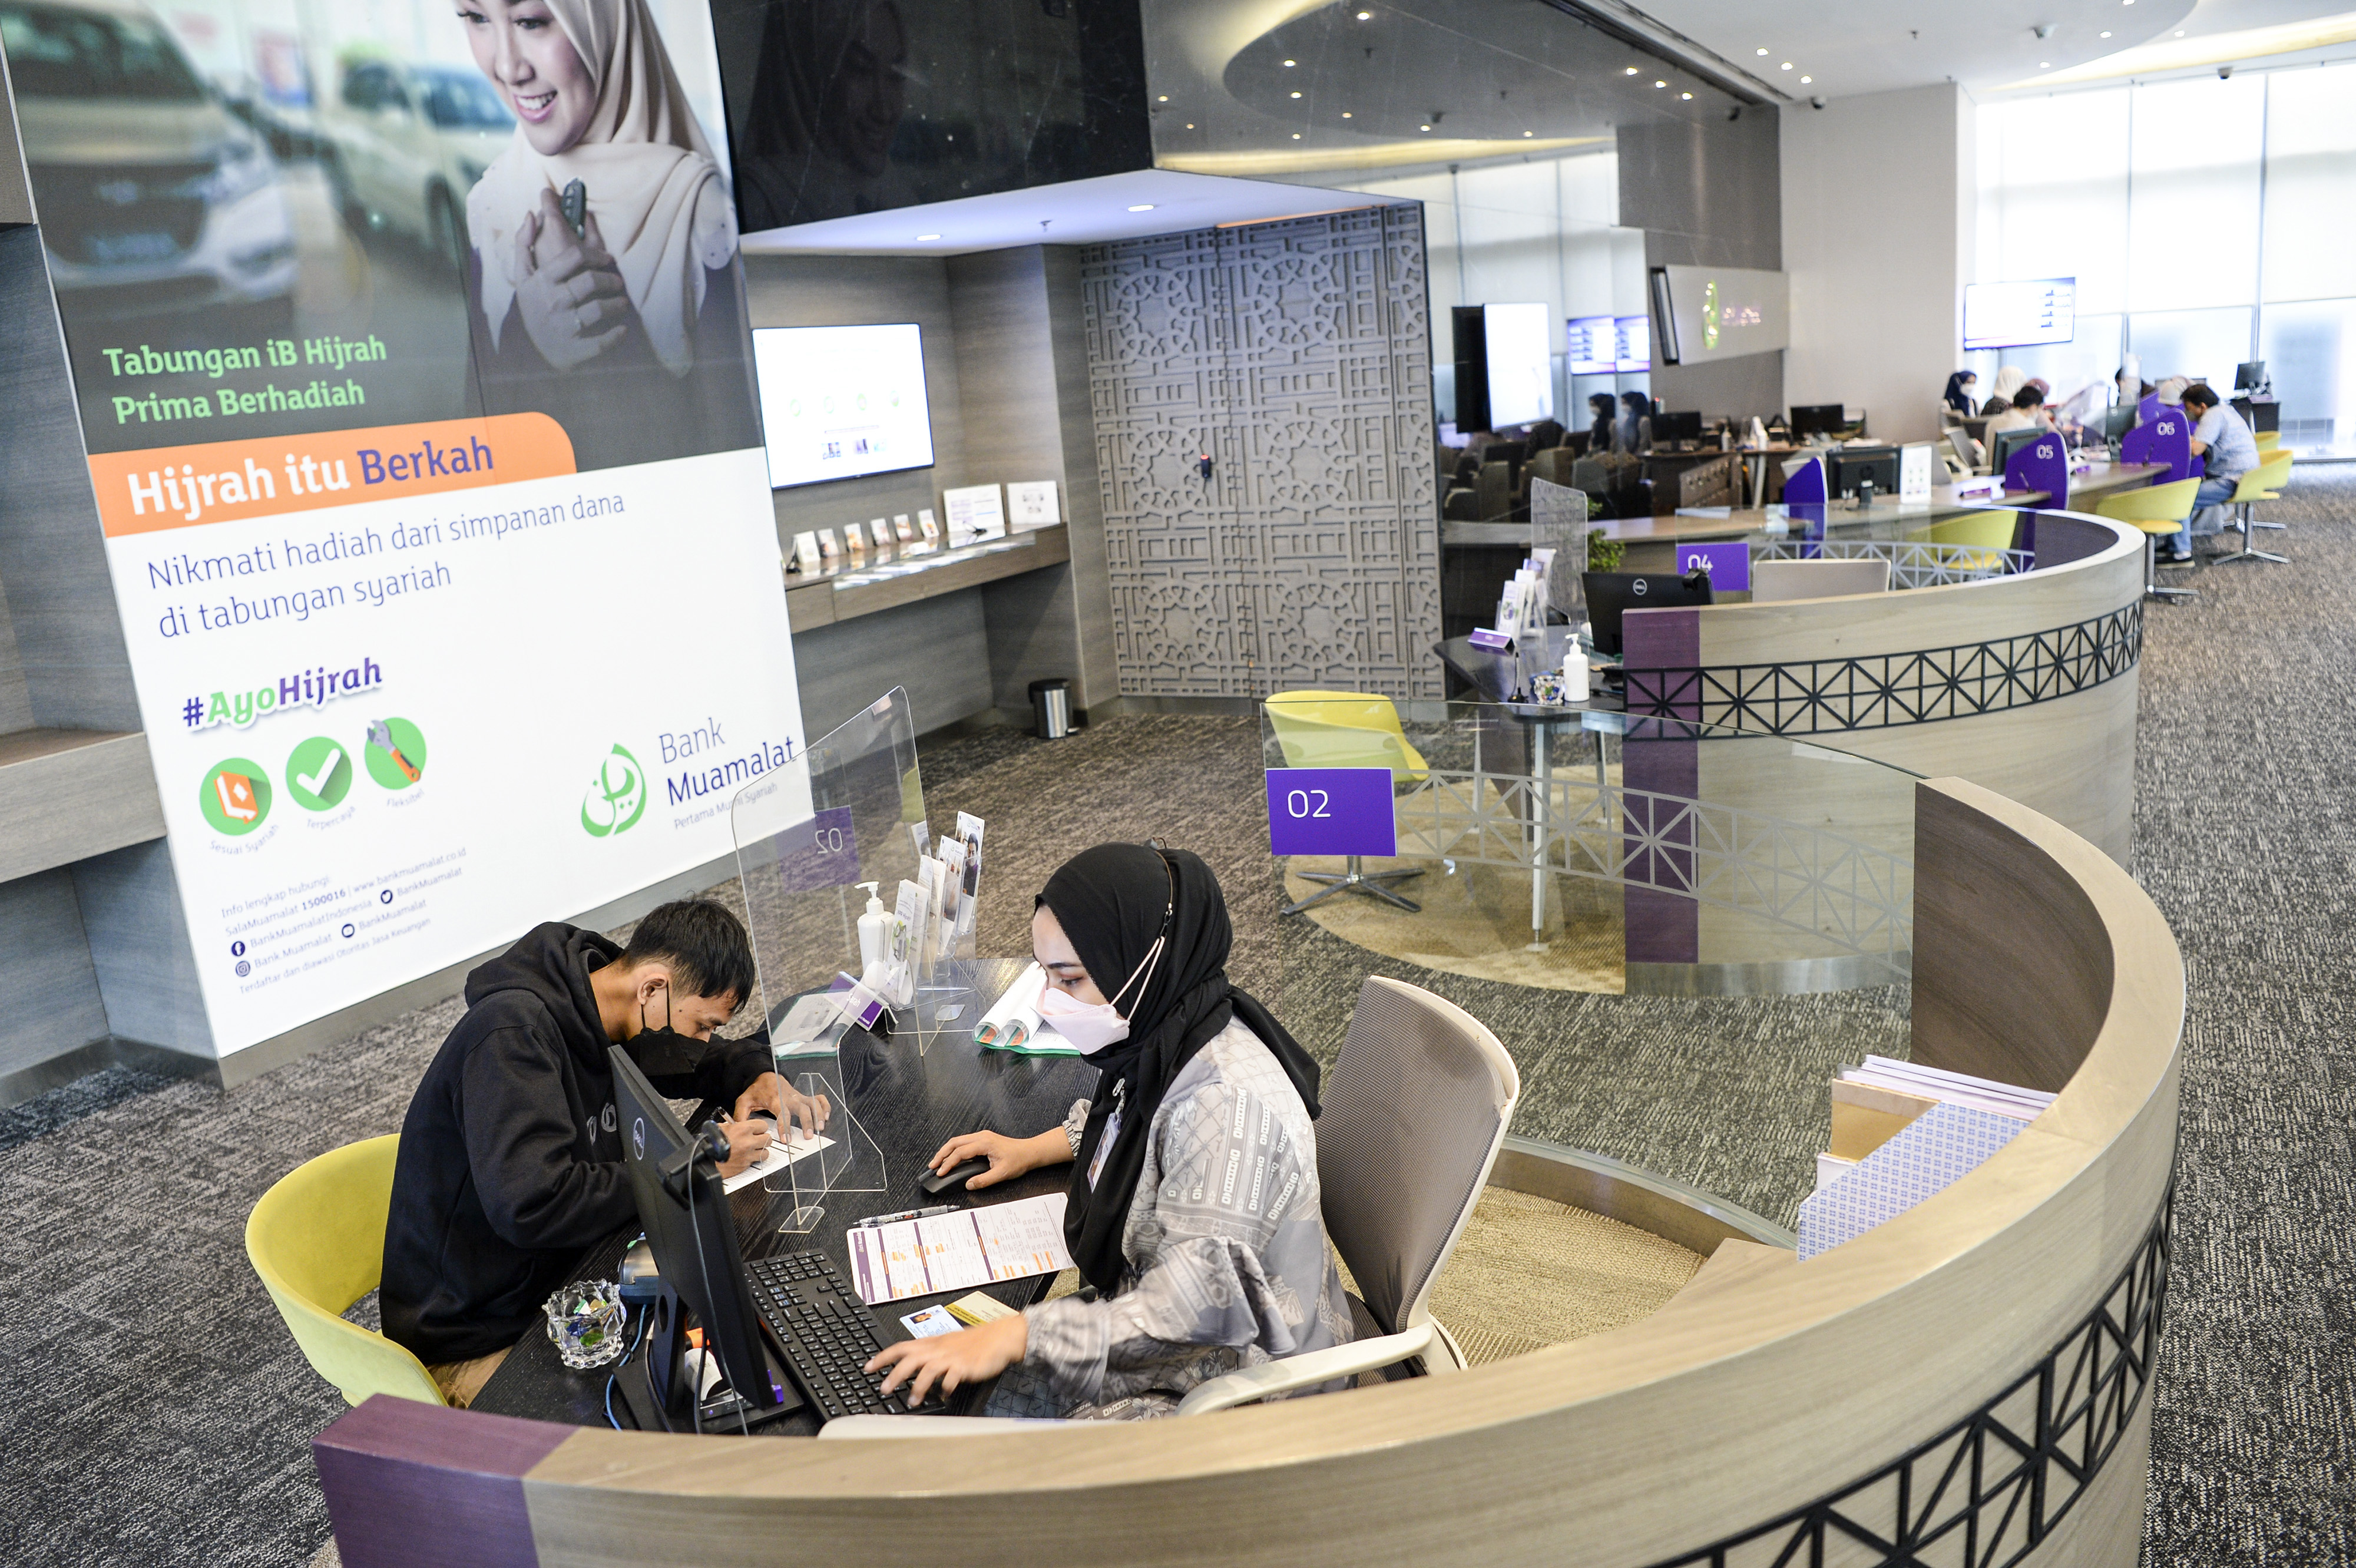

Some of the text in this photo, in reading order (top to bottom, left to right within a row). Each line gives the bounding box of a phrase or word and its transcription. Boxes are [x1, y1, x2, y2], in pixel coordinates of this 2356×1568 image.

[102, 335, 386, 378] Tabungan iB Hijrah
[112, 380, 365, 425] Prima Berhadiah
[2157, 422, 2175, 435] 06
[2036, 445, 2053, 459] 05
[127, 436, 494, 521] Hijrah itu Berkah
[148, 492, 625, 589] Nikmati hadiah dari simpanan dana
[1688, 554, 1713, 571] 04
[159, 562, 452, 638] di tabungan syariah
[183, 657, 382, 727] #AyoHijrah
[660, 717, 725, 764] Bank
[667, 736, 795, 806] Muamalat
[386, 788, 425, 808] Fleksibel
[674, 807, 714, 829] Pertama
[745, 782, 778, 804] Syariah
[1288, 789, 1331, 818] 02
[306, 805, 356, 831] Terpercaya
[210, 823, 279, 855] Sesuai Syariah
[222, 905, 243, 918] Info
[245, 891, 287, 911] lengkap
[226, 905, 299, 937] SalaMuamalat
[302, 889, 346, 911] 1500016
[240, 974, 281, 994] Terdaftar
[283, 967, 300, 978] dan
[846, 993, 861, 1007] Sarah
